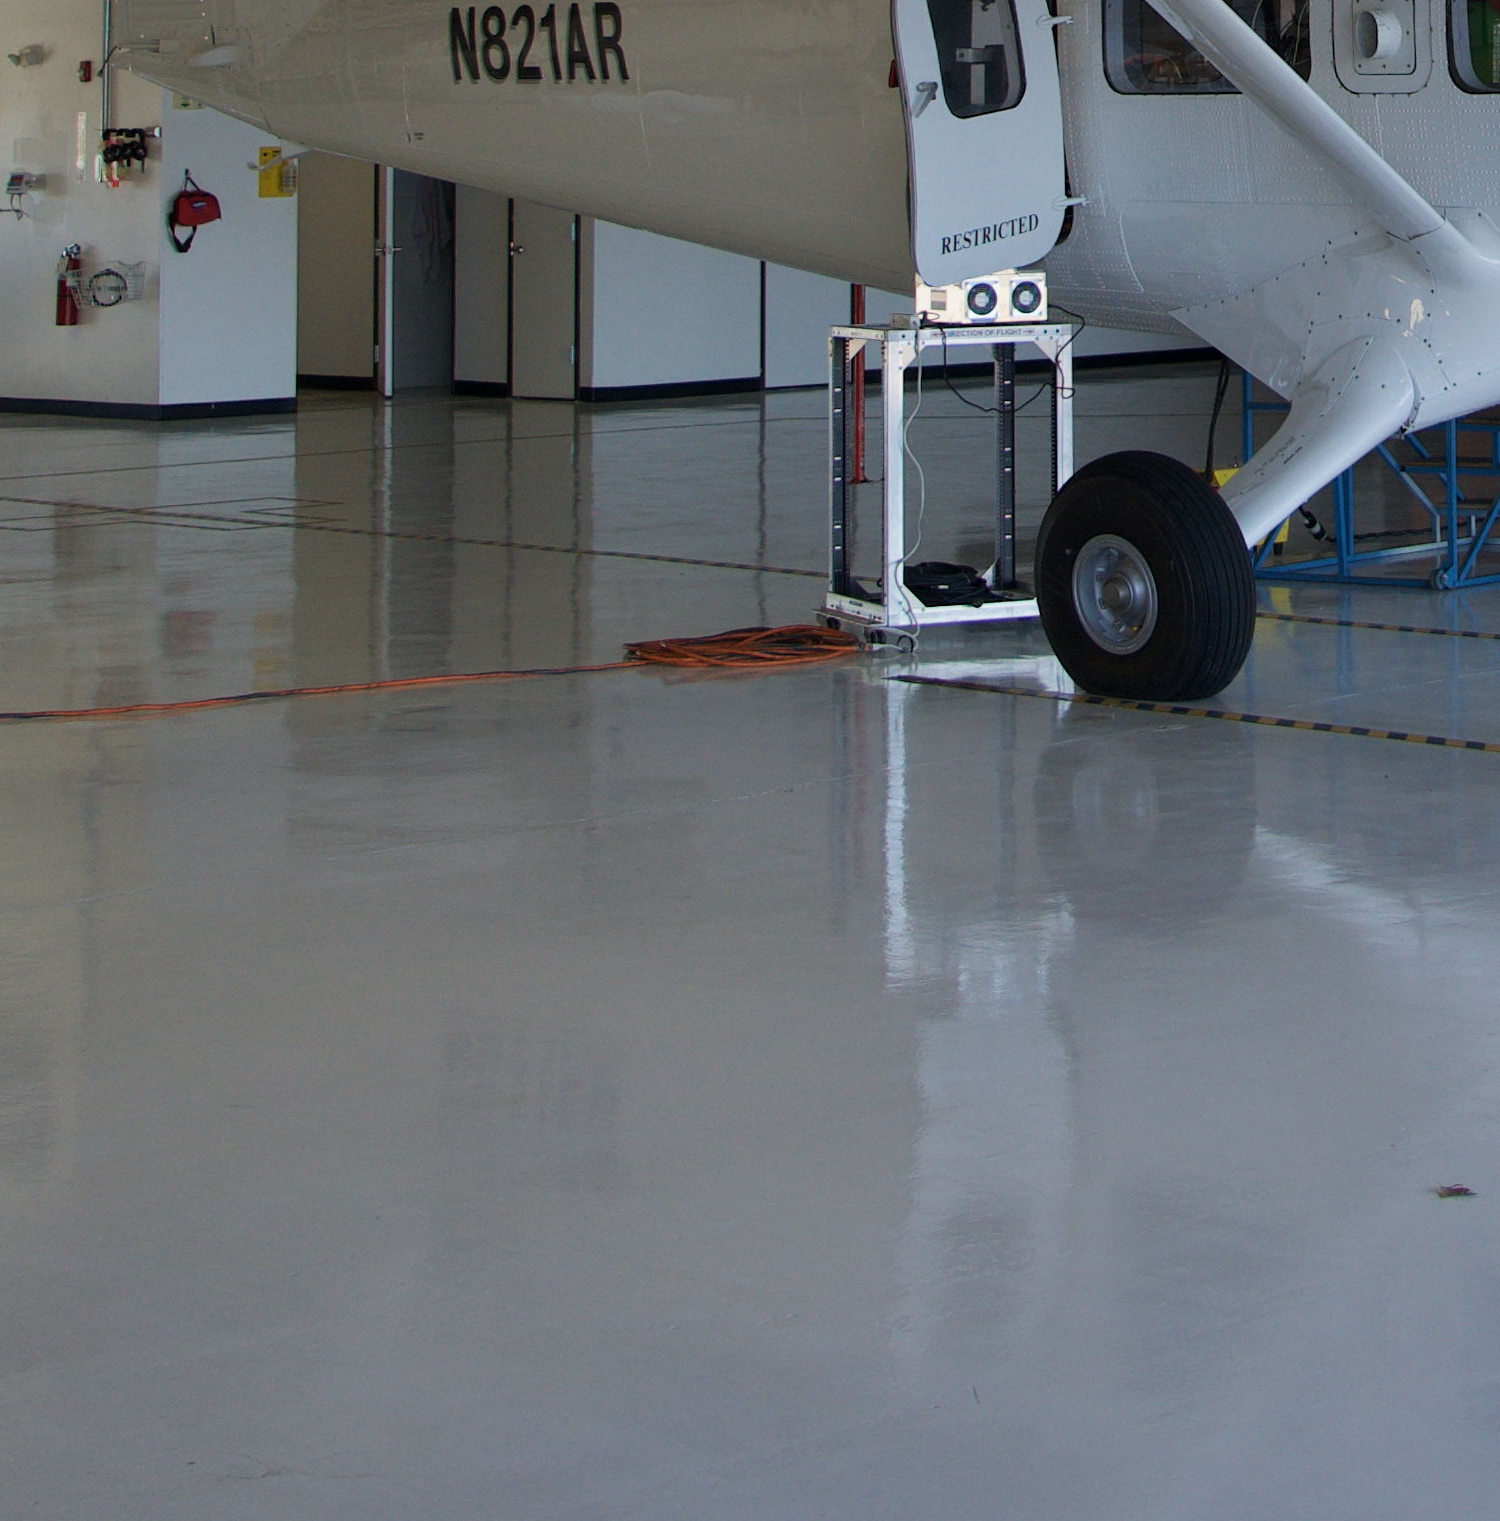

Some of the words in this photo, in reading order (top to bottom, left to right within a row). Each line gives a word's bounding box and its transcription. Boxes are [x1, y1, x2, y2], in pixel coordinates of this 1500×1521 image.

[450, 1, 630, 84] N821AR
[941, 213, 1040, 255] RESTRICTED
[944, 328, 983, 337] DIRECTION
[997, 328, 1023, 336] FLIGHT
